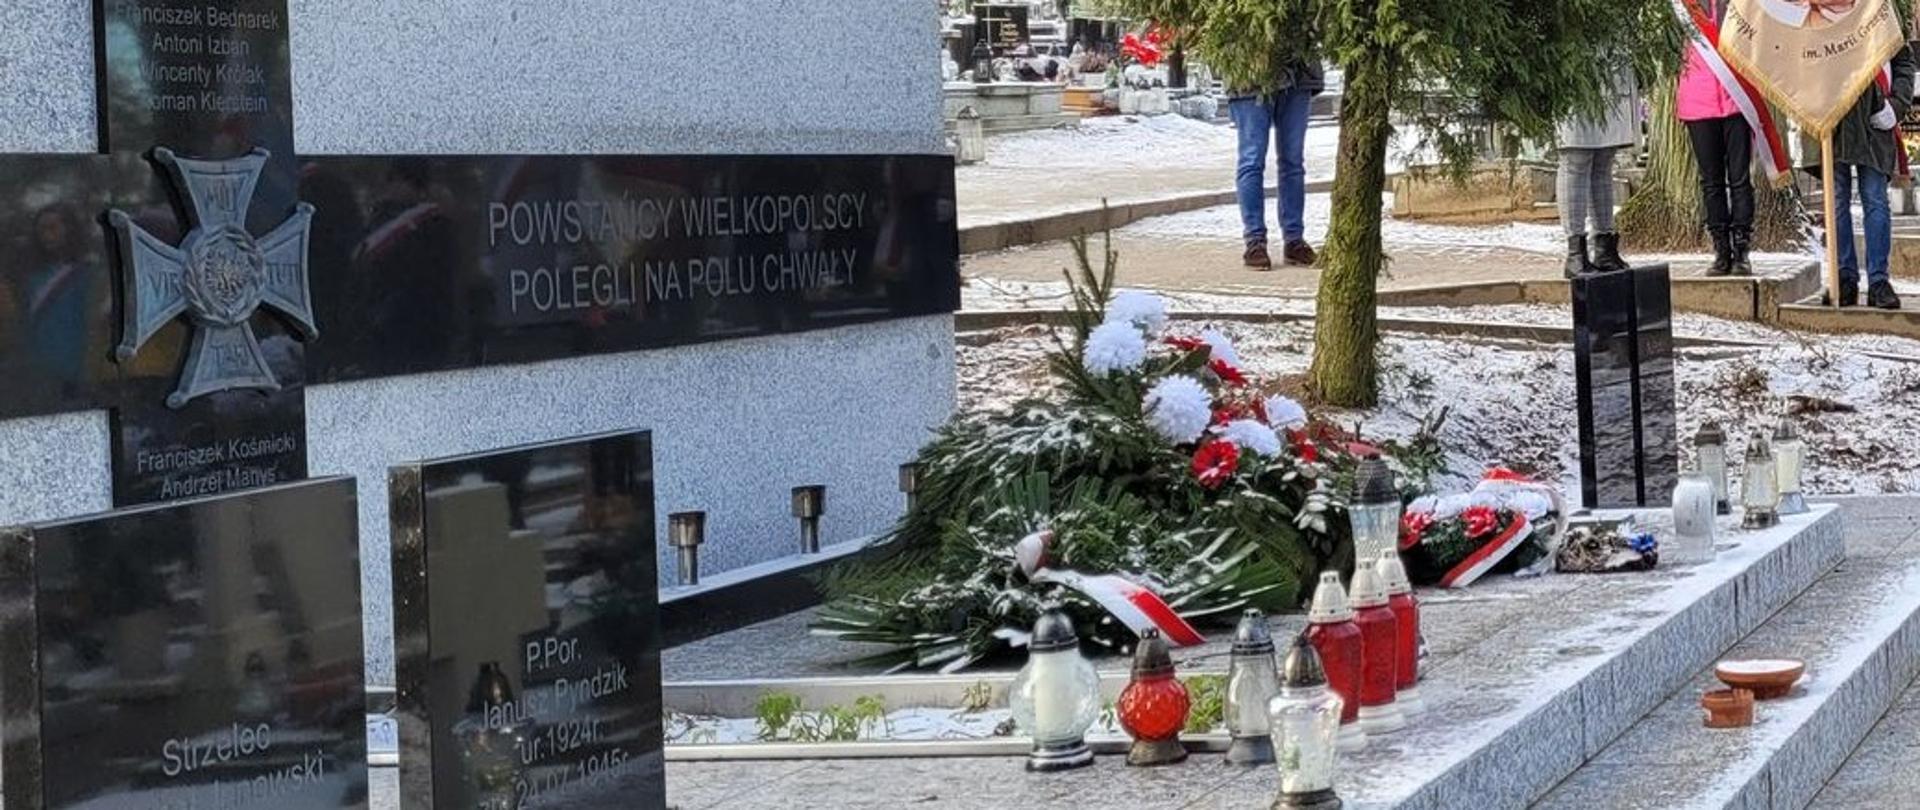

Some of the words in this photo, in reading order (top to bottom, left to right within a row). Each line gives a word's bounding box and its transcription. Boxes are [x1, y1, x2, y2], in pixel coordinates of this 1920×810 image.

[115, 2, 203, 26] Franciszek
[207, 6, 280, 31] Bednarek
[152, 33, 203, 54] Antoni
[1823, 33, 1858, 57] Marii
[140, 60, 212, 87] Wincenty
[488, 191, 673, 247] POWSTAŃCY
[681, 191, 868, 237] WIELKOPOLSCY
[510, 263, 637, 312] POLEGLI
[645, 260, 684, 302] NA
[688, 254, 757, 298] POLU
[762, 248, 858, 294] CHWAŁY
[136, 443, 225, 474] Franciszek
[228, 431, 297, 460] Kośmicki
[160, 470, 222, 500] Andrzej
[526, 637, 583, 674] P.Por.
[480, 690, 549, 733] Janusz
[554, 662, 629, 714] Pyndzik
[162, 722, 271, 776] Strzelec
